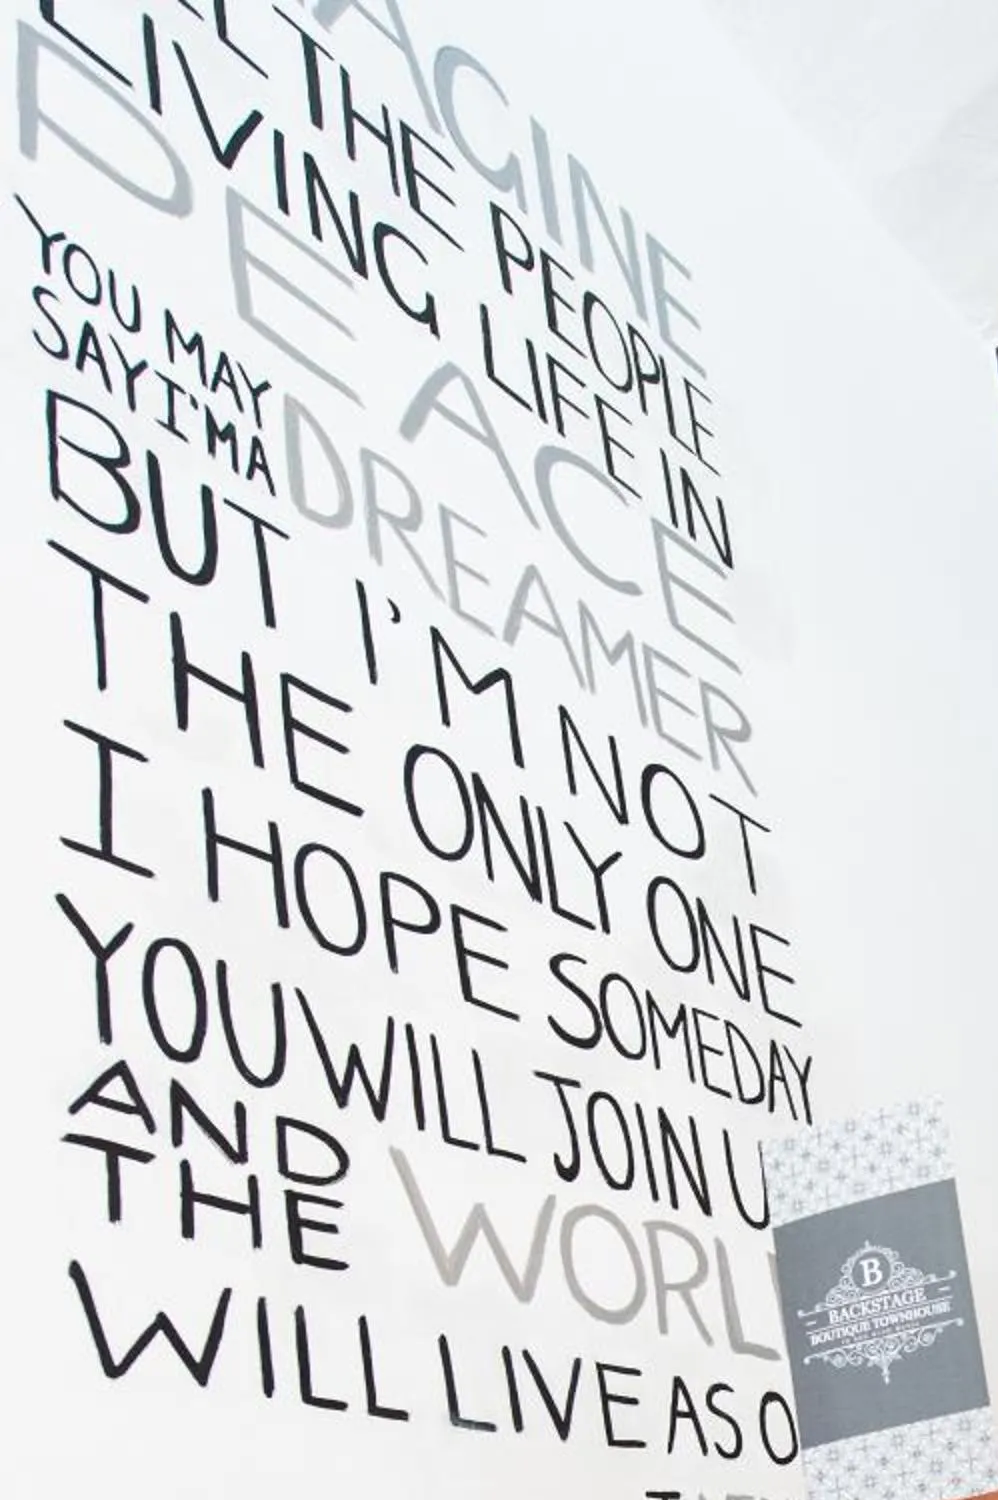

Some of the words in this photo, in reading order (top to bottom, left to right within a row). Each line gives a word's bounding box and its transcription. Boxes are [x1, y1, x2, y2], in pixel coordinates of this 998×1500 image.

[13, 193, 141, 334] YOU
[164, 308, 272, 429] MAY
[15, 18, 742, 673] PEACE
[40, 0, 441, 340] LIVING
[480, 303, 643, 500] LIFE
[660, 447, 734, 570] IN
[272, 5, 464, 252] THE
[490, 201, 721, 477] PEOPLE
[31, 285, 148, 413] SAY
[283, 393, 758, 798] DREAMER
[46, 388, 290, 628] BUT
[355, 578, 526, 768] I'M
[558, 704, 771, 896] NOT
[47, 539, 364, 818] THE
[403, 743, 624, 934] ONLY
[647, 876, 803, 1028] ONE
[59, 718, 156, 880] I
[202, 787, 521, 1022] HOPE
[548, 952, 814, 1126] SOMEDAY
[55, 892, 288, 1089] YOU
[295, 986, 527, 1163] WILL
[532, 1070, 712, 1218] JOIN
[67, 1058, 351, 1188] AND
[60, 1132, 351, 1271] THE
[389, 1144, 783, 1362] WORL
[68, 1258, 411, 1421] WILL
[437, 1333, 648, 1450] LIVE
[666, 1375, 743, 1461] AS
[810, 1319, 871, 1347] BOUTIQUE
[828, 1287, 928, 1324] BACKSTAGE
[859, 1257, 884, 1288] B
